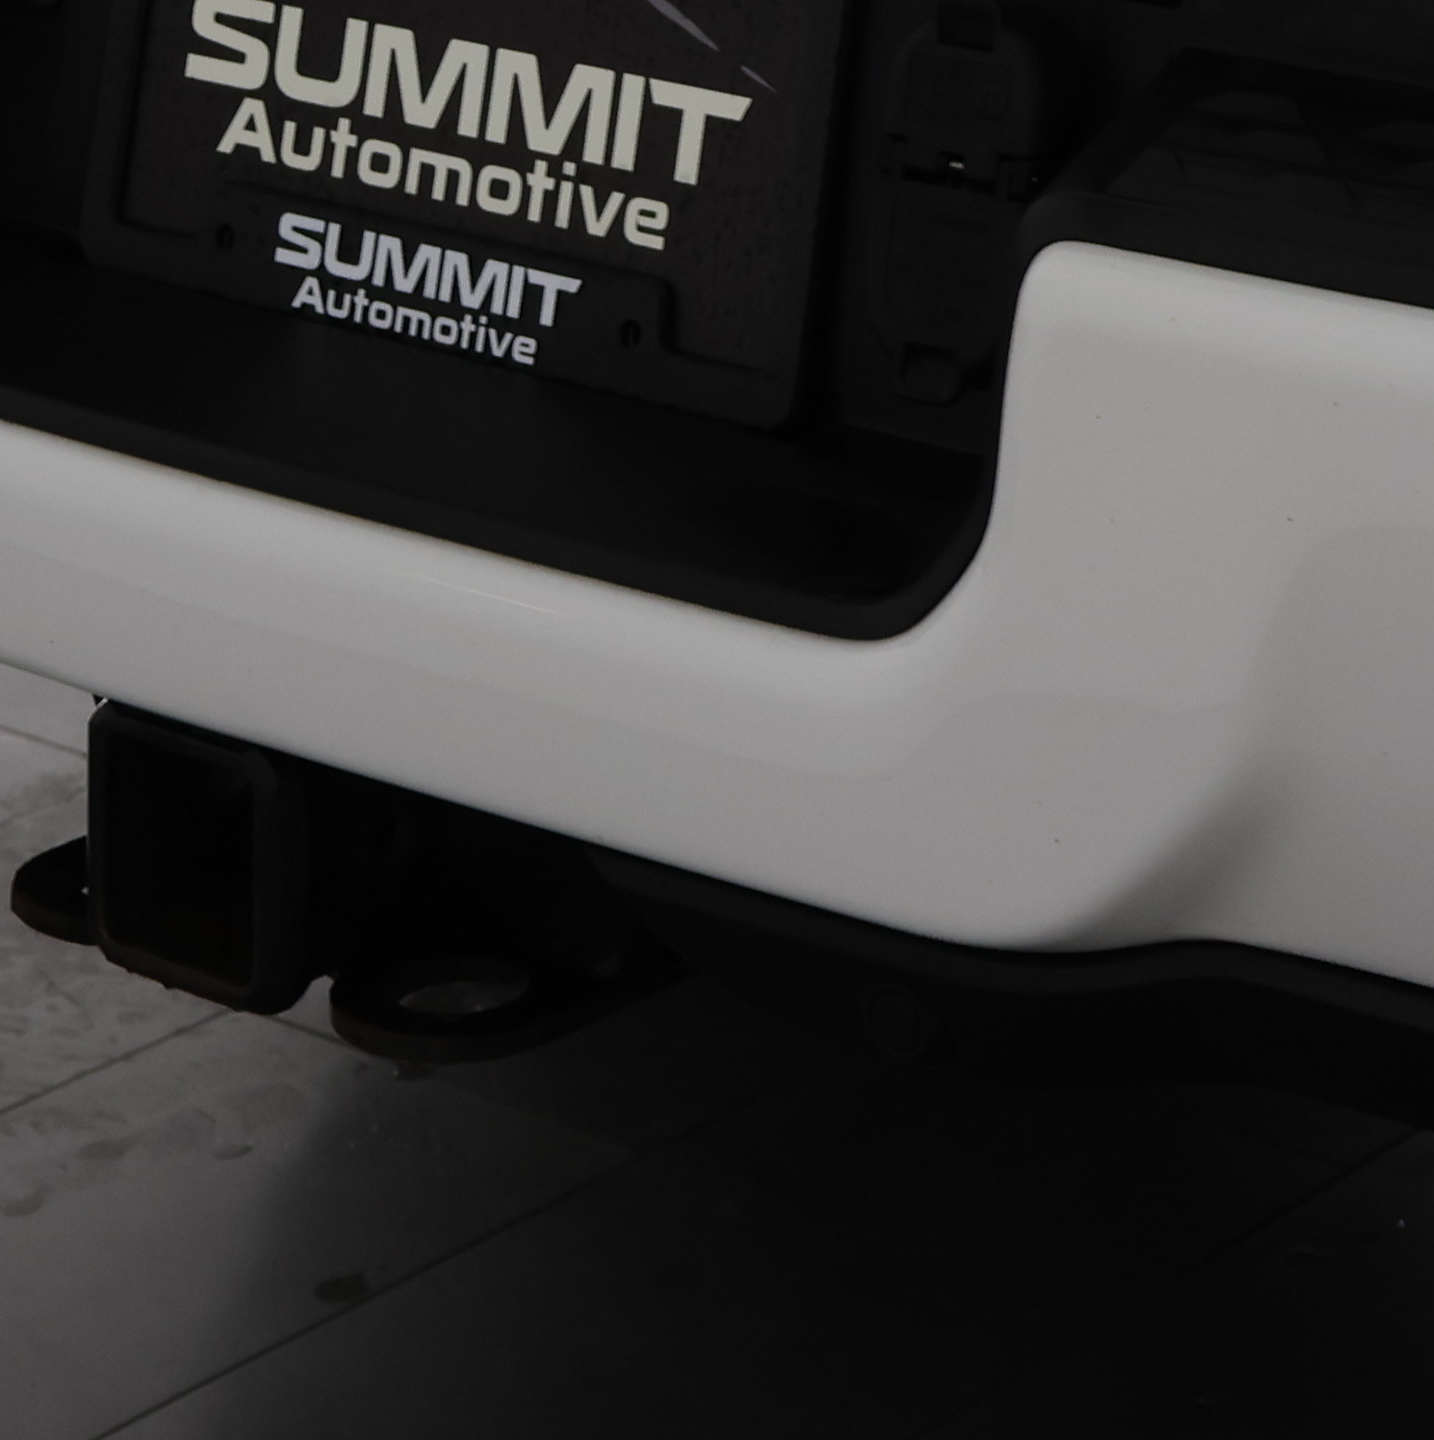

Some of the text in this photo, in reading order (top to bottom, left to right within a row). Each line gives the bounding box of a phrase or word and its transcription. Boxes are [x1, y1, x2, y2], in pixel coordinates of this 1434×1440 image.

[216, 96, 670, 251] Automotive
[273, 211, 582, 328] SUMMIT
[291, 276, 538, 366] Automotive
